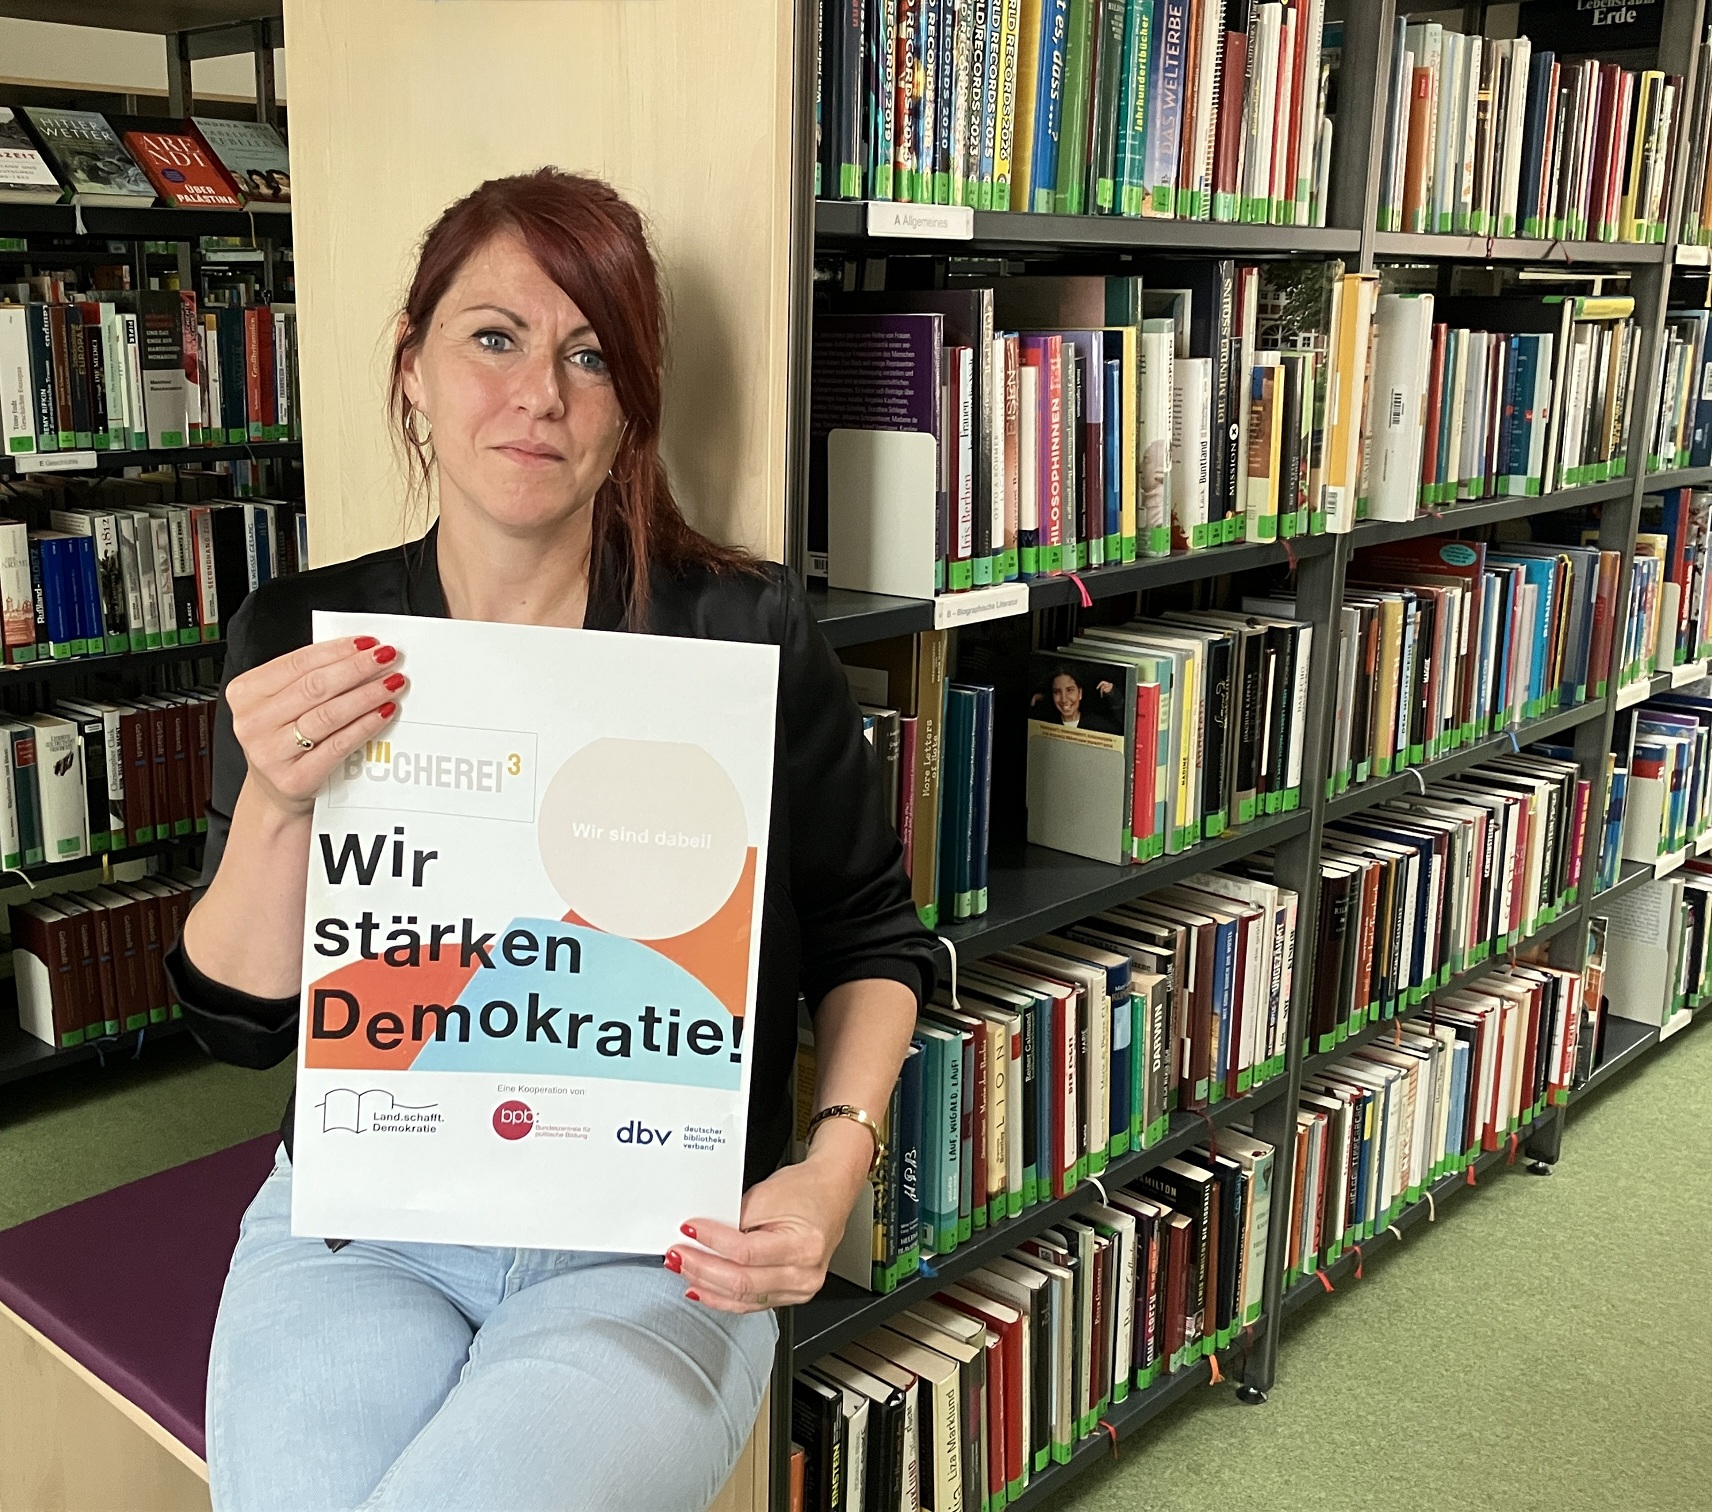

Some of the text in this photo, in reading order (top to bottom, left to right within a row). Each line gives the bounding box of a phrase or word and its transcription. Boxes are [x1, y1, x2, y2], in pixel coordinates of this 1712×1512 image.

[1592, 7, 1637, 26] Erde
[885, 2, 894, 141] RECORDS 2019
[904, 12, 914, 109] RECORDS
[925, 12, 935, 100] RECORDS
[1049, 48, 1064, 100] dass
[1134, 14, 1149, 133] Jahrhundertbücher
[941, 14, 952, 149] RECORDS 2020
[969, 29, 984, 155] RECORDS 2023
[984, 32, 999, 158] RECORDS 2025
[1000, 33, 1015, 160] RECORDS 2026
[1162, 4, 1183, 155] DAS WELTERBE
[40, 116, 98, 131] HITLER
[40, 127, 114, 142] WETTER
[176, 192, 237, 205] PALÄSTINA
[184, 183, 215, 196] ÜBER
[893, 215, 948, 229] A Allgemeines
[76, 323, 87, 375] EUROPAS
[250, 317, 258, 378] Großbritannien
[1216, 277, 1232, 424] DIE MENDELSSOHNS
[959, 400, 970, 438] Frauen
[1051, 397, 1061, 546] HILOSOPHINNEN
[1198, 440, 1208, 484] Buntland
[1228, 442, 1238, 496] MISSION
[960, 473, 972, 550] Iris Berben
[101, 519, 112, 546] 1812
[957, 601, 996, 616] Biographische
[996, 597, 1018, 609] Literatur
[1542, 567, 1554, 638] RUNNING
[1392, 656, 1400, 687] ICH
[135, 724, 143, 758] Gebhardt
[156, 721, 164, 755] Gebhardt
[199, 715, 207, 748] Gebhardt
[1243, 710, 1251, 743] JOACHIM
[110, 749, 118, 792] Christopher
[922, 719, 933, 797] More Letters
[931, 766, 937, 778] of
[572, 821, 713, 849] Wir sind dabei!
[319, 825, 438, 888] Wir
[313, 911, 582, 974] stärken
[1271, 923, 1284, 991] UNGEZÄHMT
[310, 988, 744, 1064] Demokratie!
[1152, 1003, 1163, 1072] DARWIN
[497, 1084, 588, 1096] Eine Kooperation von:
[996, 1045, 1005, 1129] LION
[372, 1111, 445, 1124] Land.schafft.
[372, 1122, 437, 1134] Demokratie
[500, 1107, 540, 1125] bpb:
[582, 1125, 592, 1133] für
[948, 1058, 959, 1162] LAUF, WIGALD, LAUF!
[534, 1131, 589, 1140] politische Bildung
[616, 1120, 672, 1147] dbv
[683, 1133, 726, 1145] bibliotheks
[683, 1142, 715, 1152] verband
[684, 1125, 723, 1136] deutscher
[1352, 1104, 1362, 1167] TIMMERBERG
[1203, 1184, 1211, 1225] BIOGRAFIE
[1198, 1241, 1207, 1280] HAMILTON
[1148, 1293, 1156, 1333] GREEN
[1197, 1282, 1205, 1306] LEWIS
[945, 1389, 957, 1453] Marklund
[947, 1455, 959, 1482] Liza
